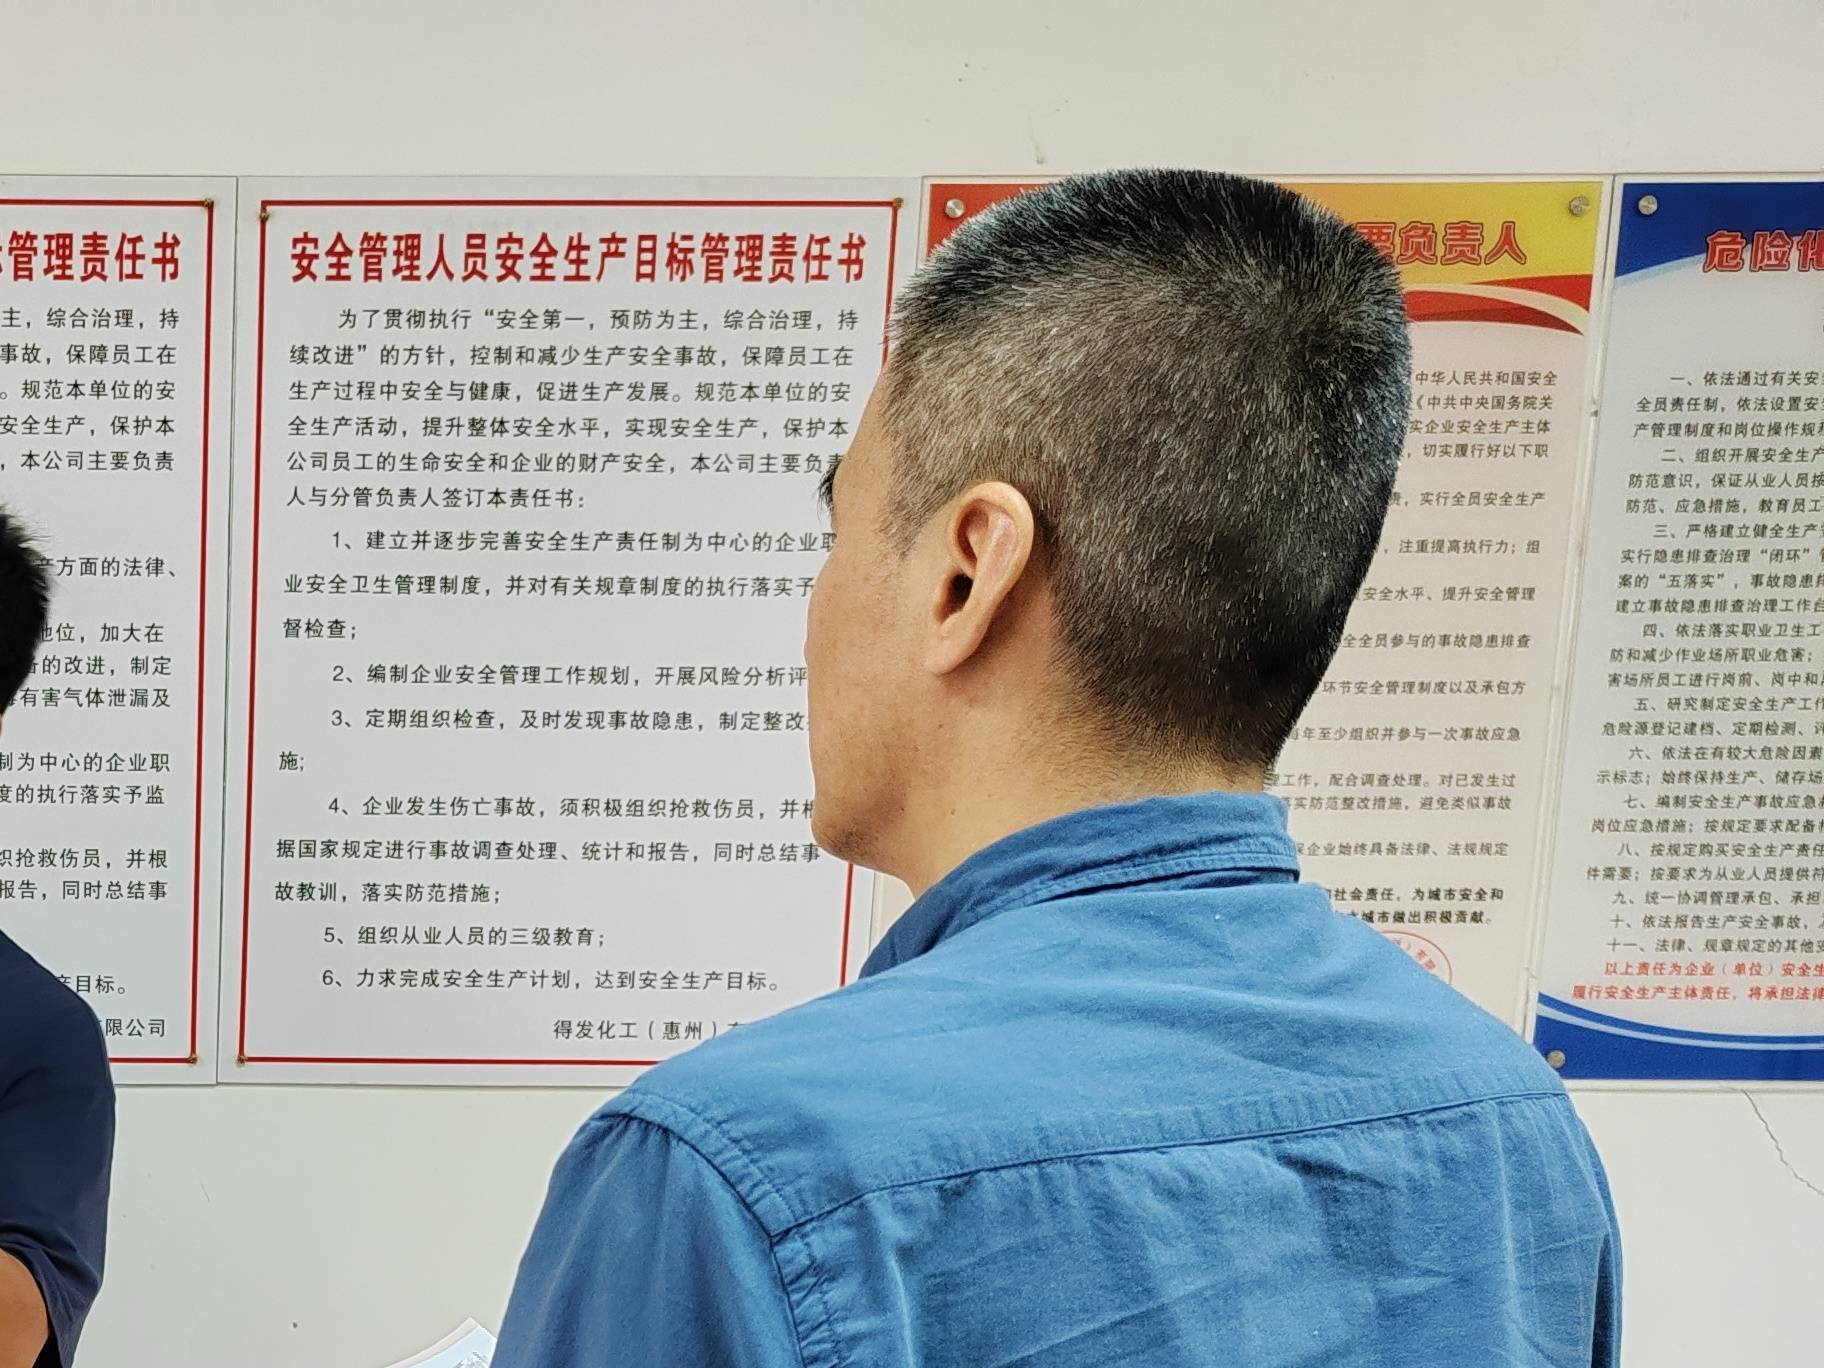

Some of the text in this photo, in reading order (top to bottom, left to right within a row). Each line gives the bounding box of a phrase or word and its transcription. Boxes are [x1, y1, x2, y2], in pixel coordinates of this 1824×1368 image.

[290, 230, 867, 284] 安全管理人员安全生产目标管理责任书
[288, 378, 851, 405] 生产过程中安全与健康，促进生产发展。规范本单位的安
[287, 414, 849, 440] 全生产活动，提升整体安全水平，实现安全生产，保护本
[286, 485, 585, 510] 人与分管负责人签订本责任书：
[1625, 499, 1824, 515] 防范、应急措施，教育员工
[9, 687, 172, 708] 有害气体泄漏及
[331, 707, 809, 732] 3、定期组织检查，及时发现事故隐患，制定整改
[1327, 887, 1504, 902] 社会责任，为城市安全和
[321, 968, 778, 993] 6、力求完成安全生产计划，达到安全生产目标。
[552, 1019, 743, 1041] 得发化工（惠州）
